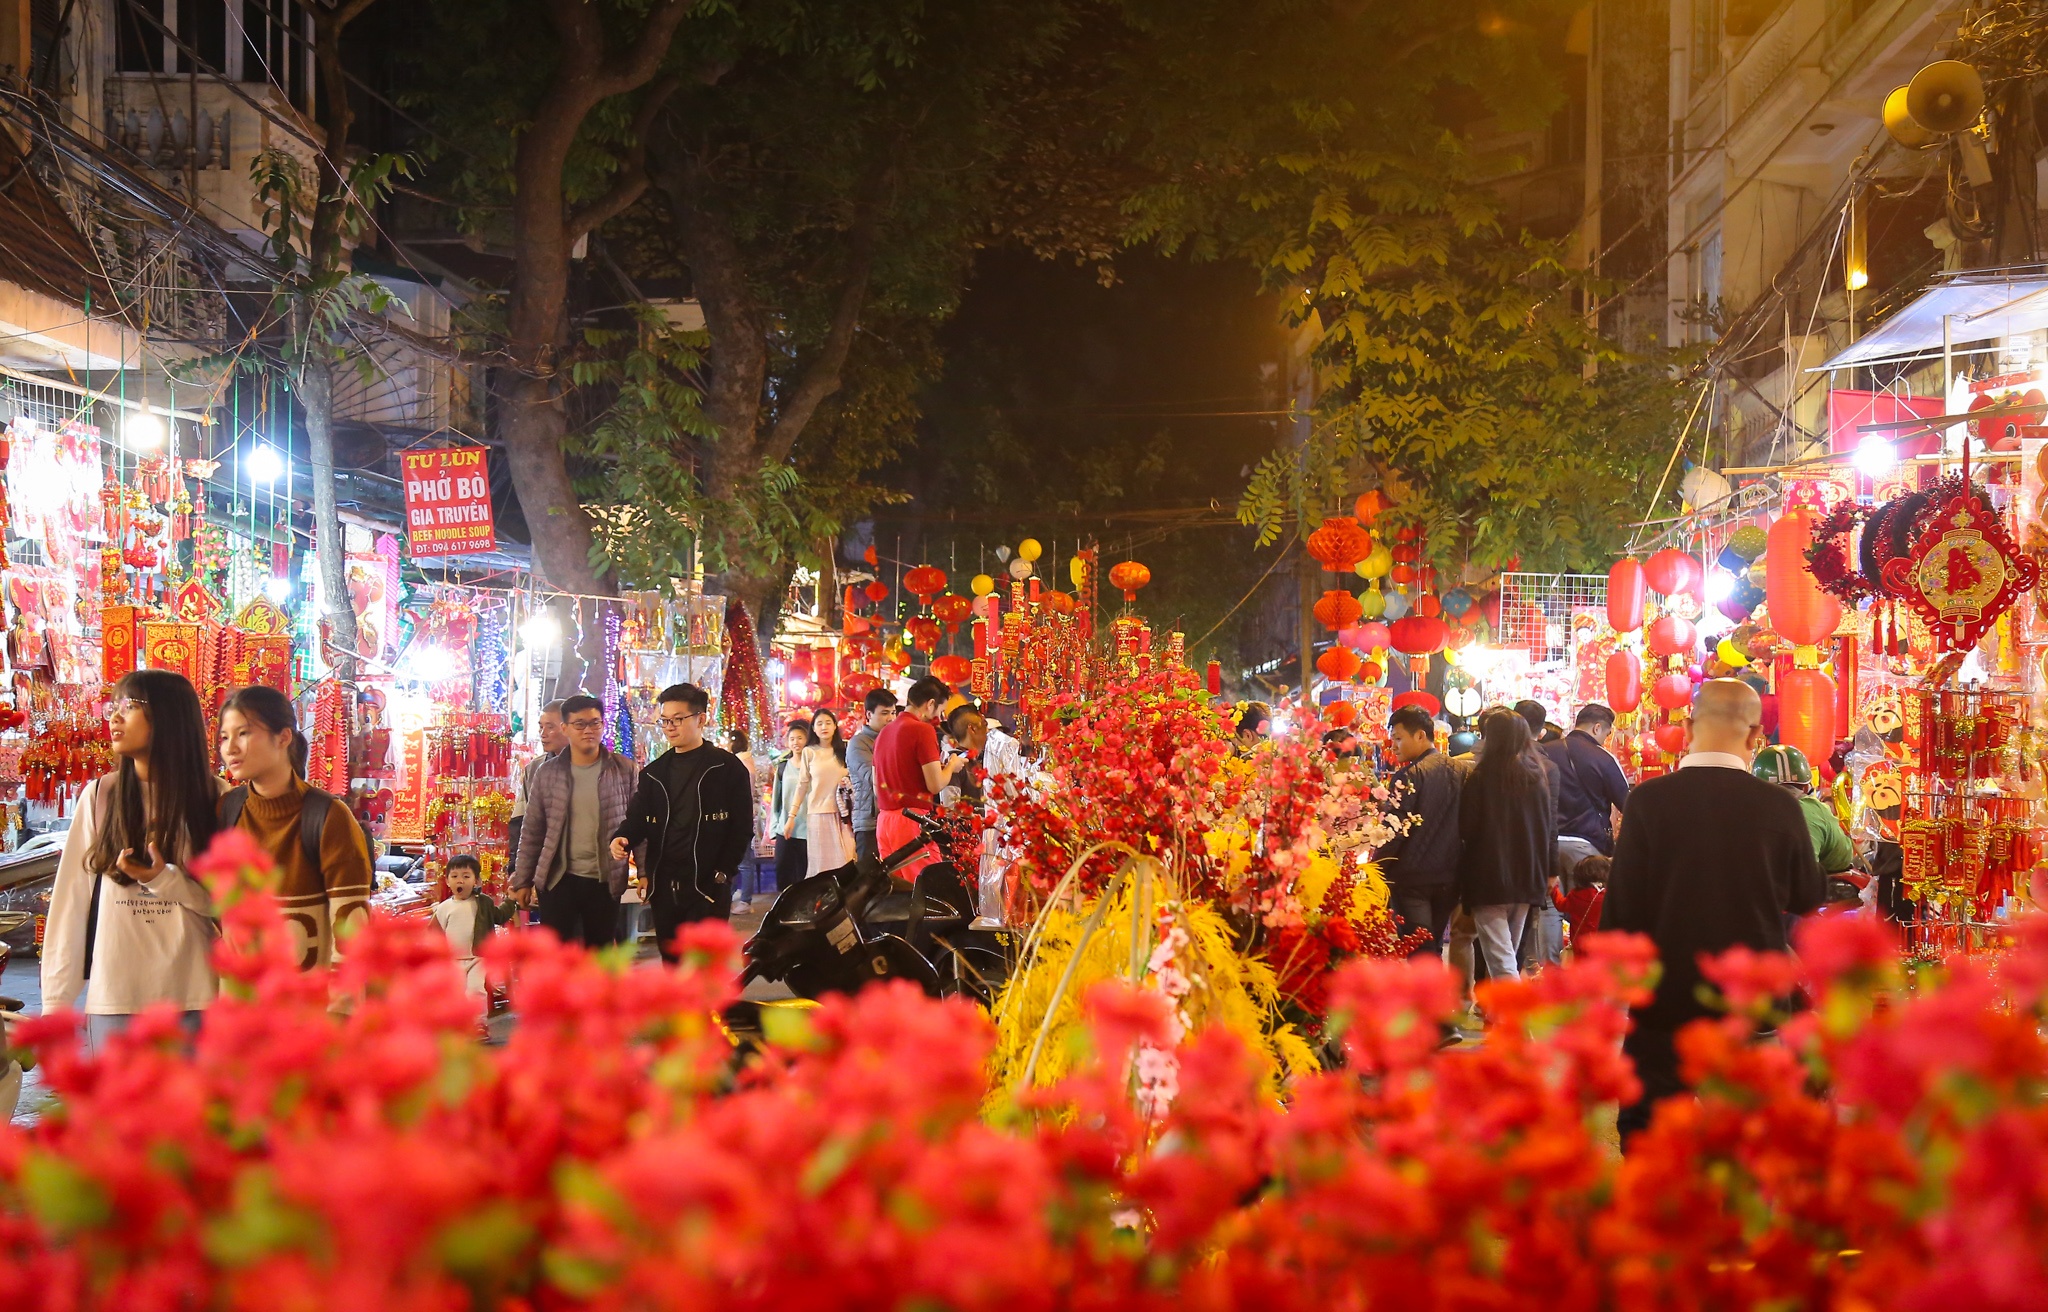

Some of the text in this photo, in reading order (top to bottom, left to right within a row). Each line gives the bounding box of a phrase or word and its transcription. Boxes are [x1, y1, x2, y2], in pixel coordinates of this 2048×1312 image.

[407, 452, 436, 469] TƯ
[408, 470, 486, 503] PHỞ BÒ
[410, 499, 489, 526] GIA TRUYỀN
[412, 525, 491, 542] BEEF NOODLE SOUP
[415, 543, 431, 553] ĐT:
[450, 541, 467, 551] 617
[469, 539, 491, 550] 9698
